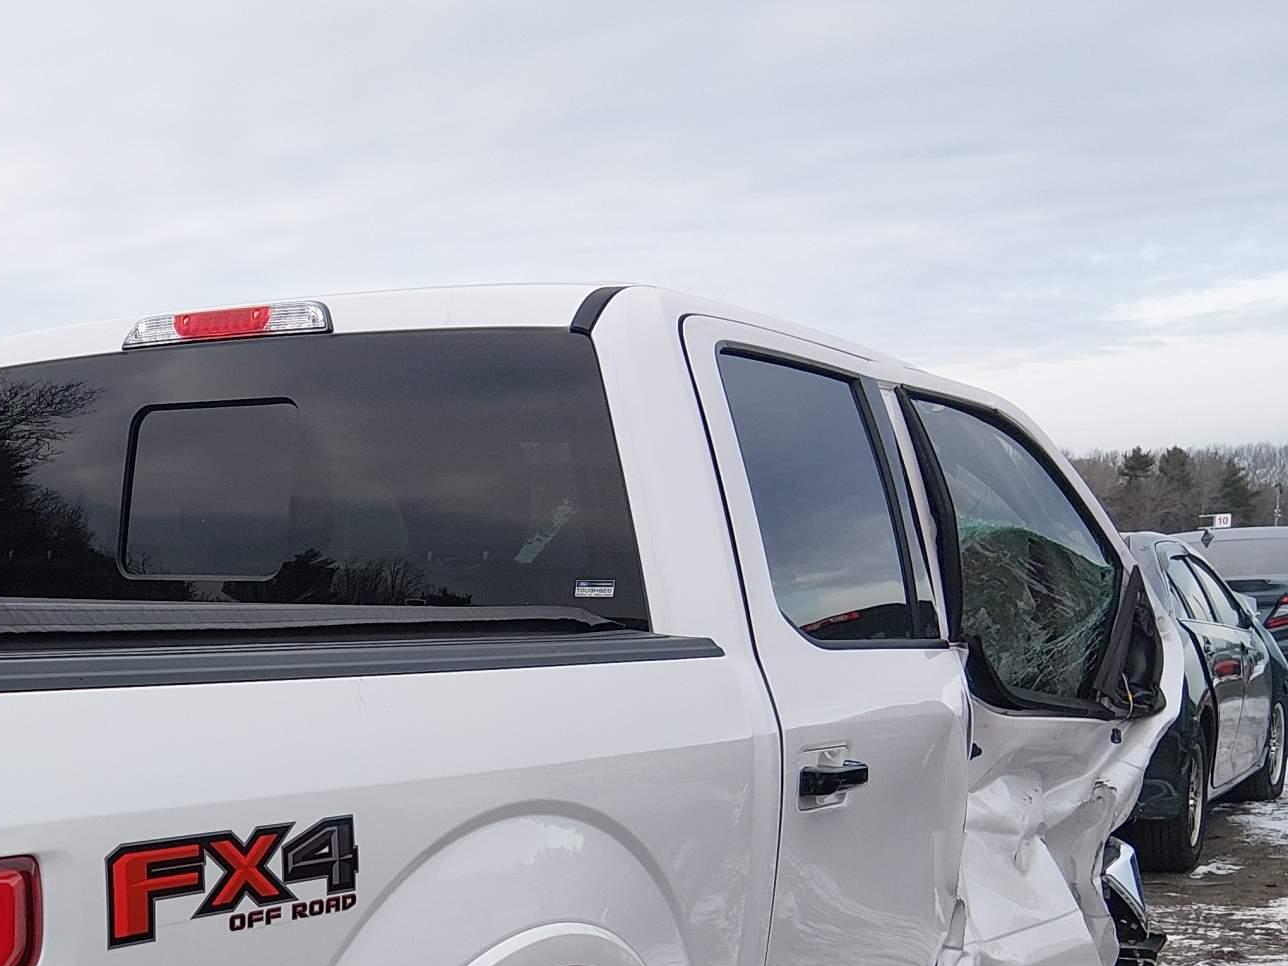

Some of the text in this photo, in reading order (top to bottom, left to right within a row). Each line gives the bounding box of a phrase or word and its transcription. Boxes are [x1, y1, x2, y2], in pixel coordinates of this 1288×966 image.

[1217, 516, 1229, 525] 10
[105, 814, 359, 950] FX4
[229, 893, 357, 931] OFF ROAD
